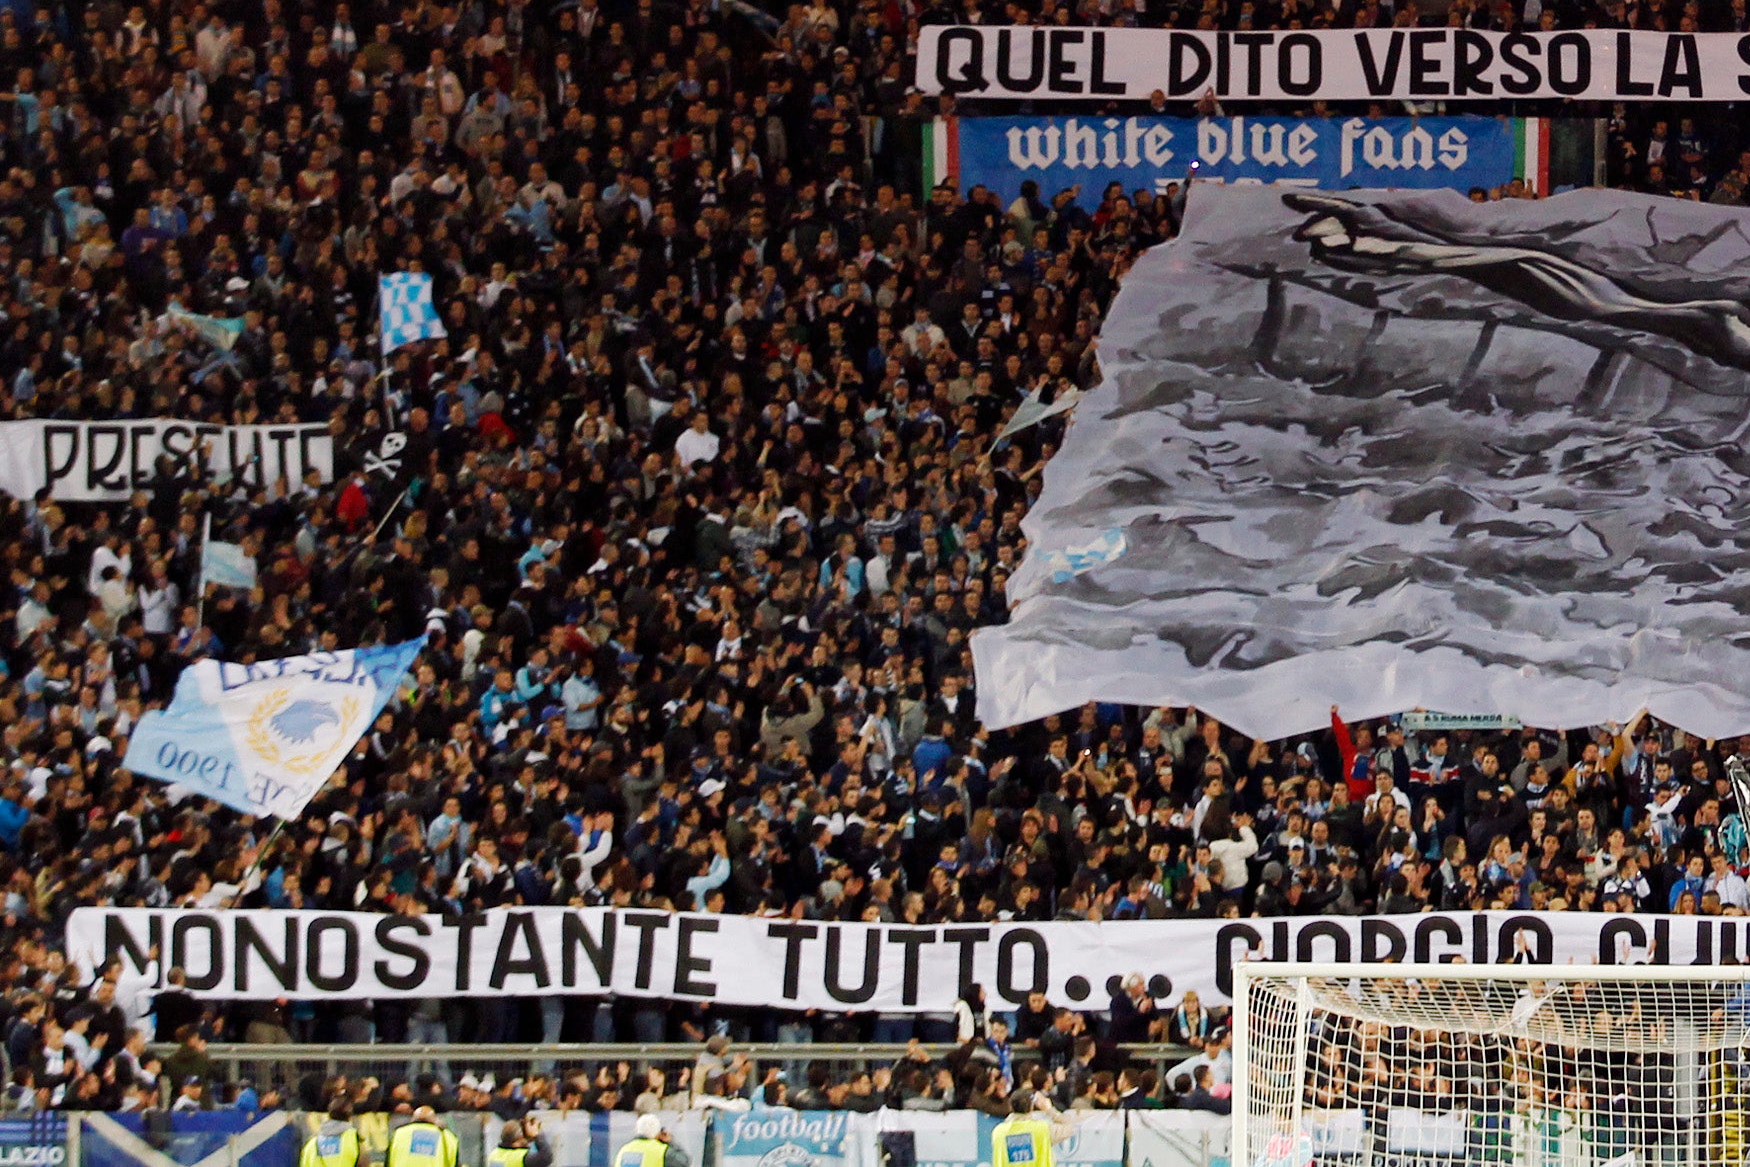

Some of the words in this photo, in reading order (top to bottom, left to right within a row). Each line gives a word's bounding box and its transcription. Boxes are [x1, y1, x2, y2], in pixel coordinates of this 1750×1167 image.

[936, 26, 1127, 96] QUEL
[1167, 31, 1323, 97] DITO
[1354, 30, 1591, 97] VERSO
[1616, 33, 1703, 98] LA
[1006, 117, 1174, 172] white
[1198, 119, 1320, 169] blue
[1340, 117, 1469, 179] fans
[104, 912, 719, 998] NONOSTANTE
[0, 1146, 66, 1166] LAZIO
[729, 1113, 844, 1150] football
